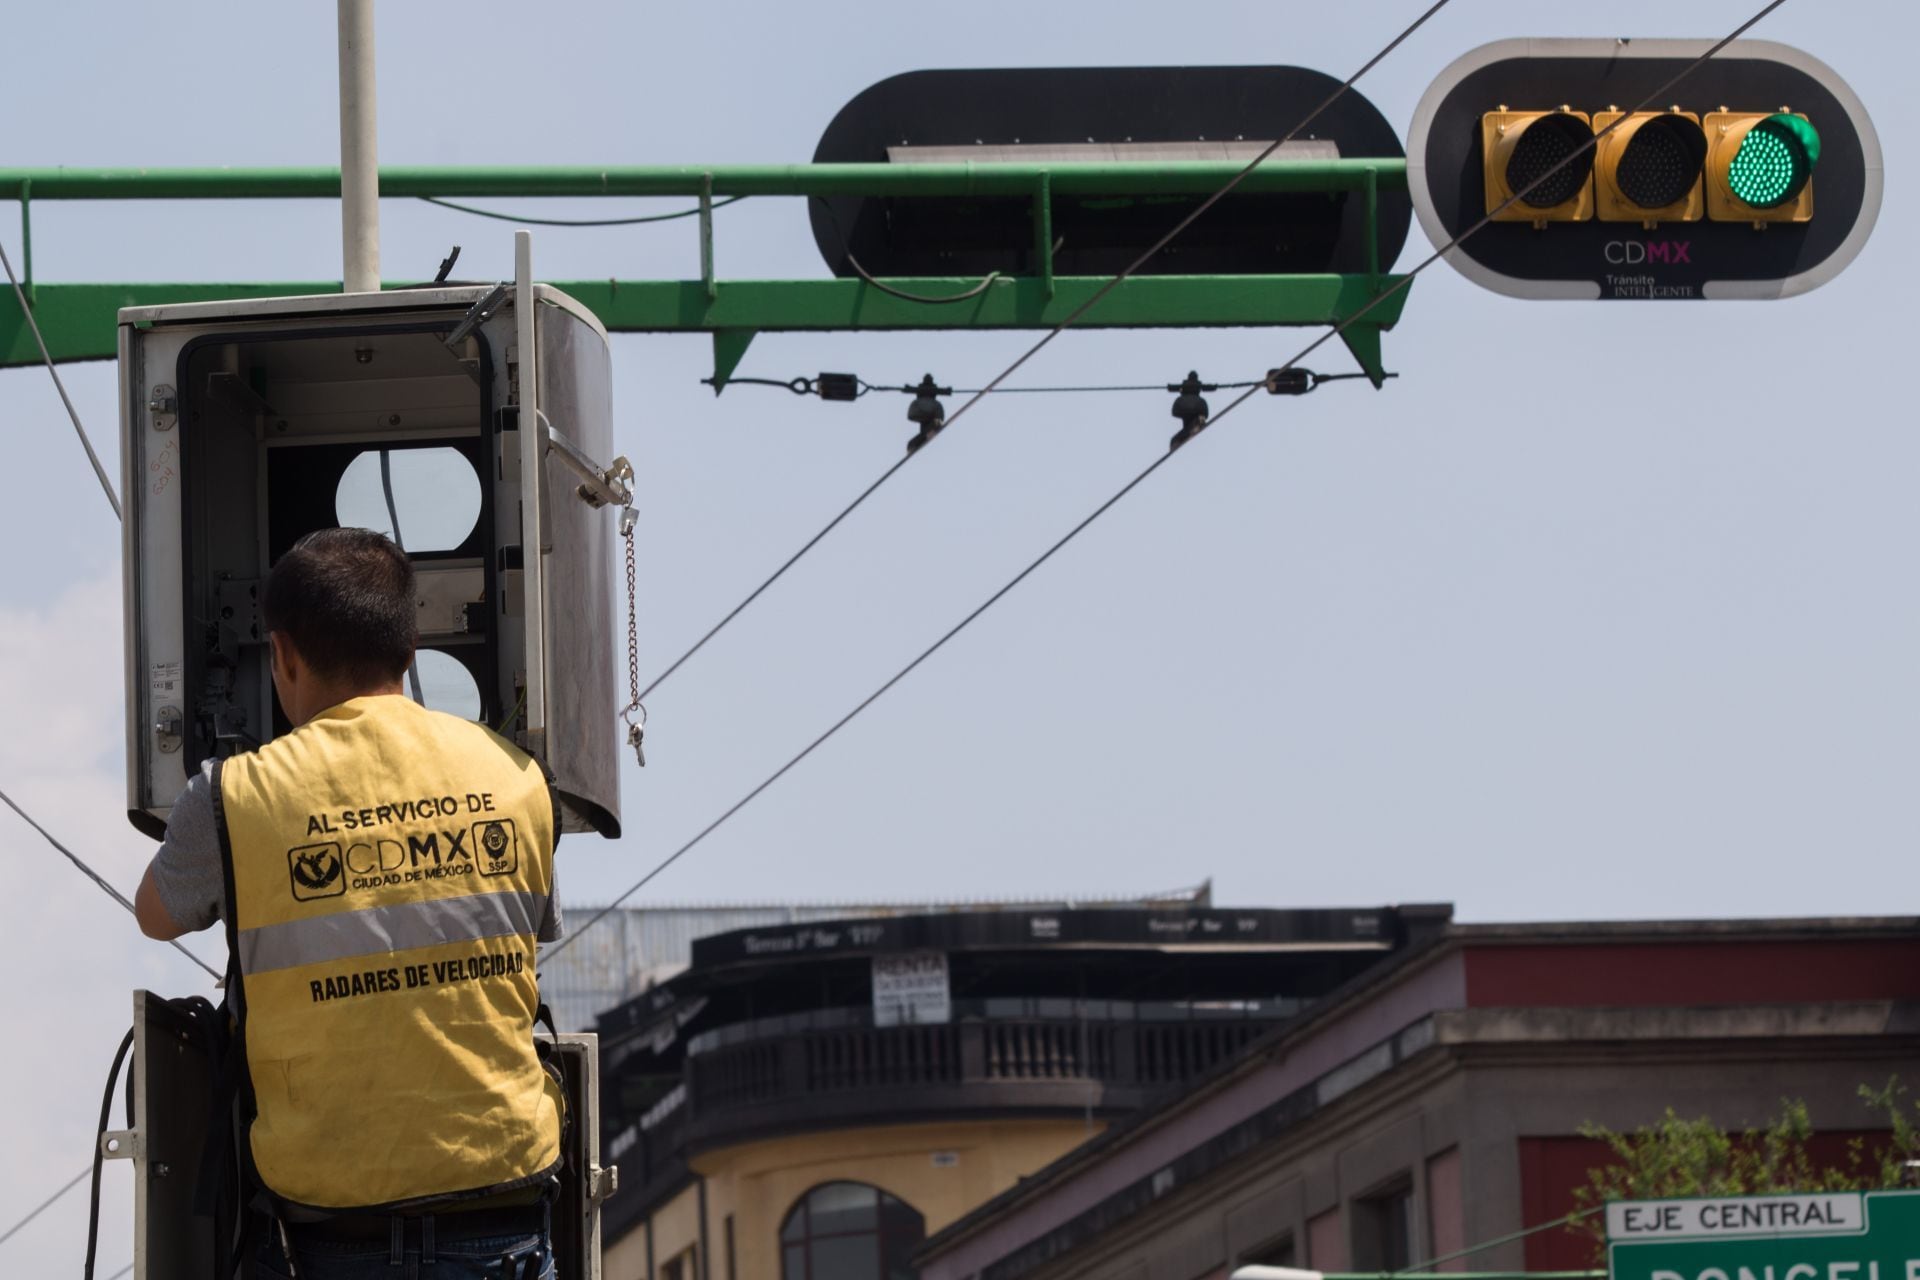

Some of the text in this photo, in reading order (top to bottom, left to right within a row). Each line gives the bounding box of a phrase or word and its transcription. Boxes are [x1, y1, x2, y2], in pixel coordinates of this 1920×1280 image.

[1604, 240, 1691, 264] CDMX
[1606, 274, 1655, 286] Tránsito
[1615, 285, 1694, 299] INTELIGENTE
[306, 793, 496, 836] AL SERVICIO DE
[346, 829, 472, 875] CDMX
[352, 863, 474, 890] CIUDAD DE MÉXICO
[488, 860, 508, 872] SSP
[310, 951, 523, 1002] RADARES DE VELOCIDAD
[1623, 1200, 1846, 1232] EJE CENTRAL
